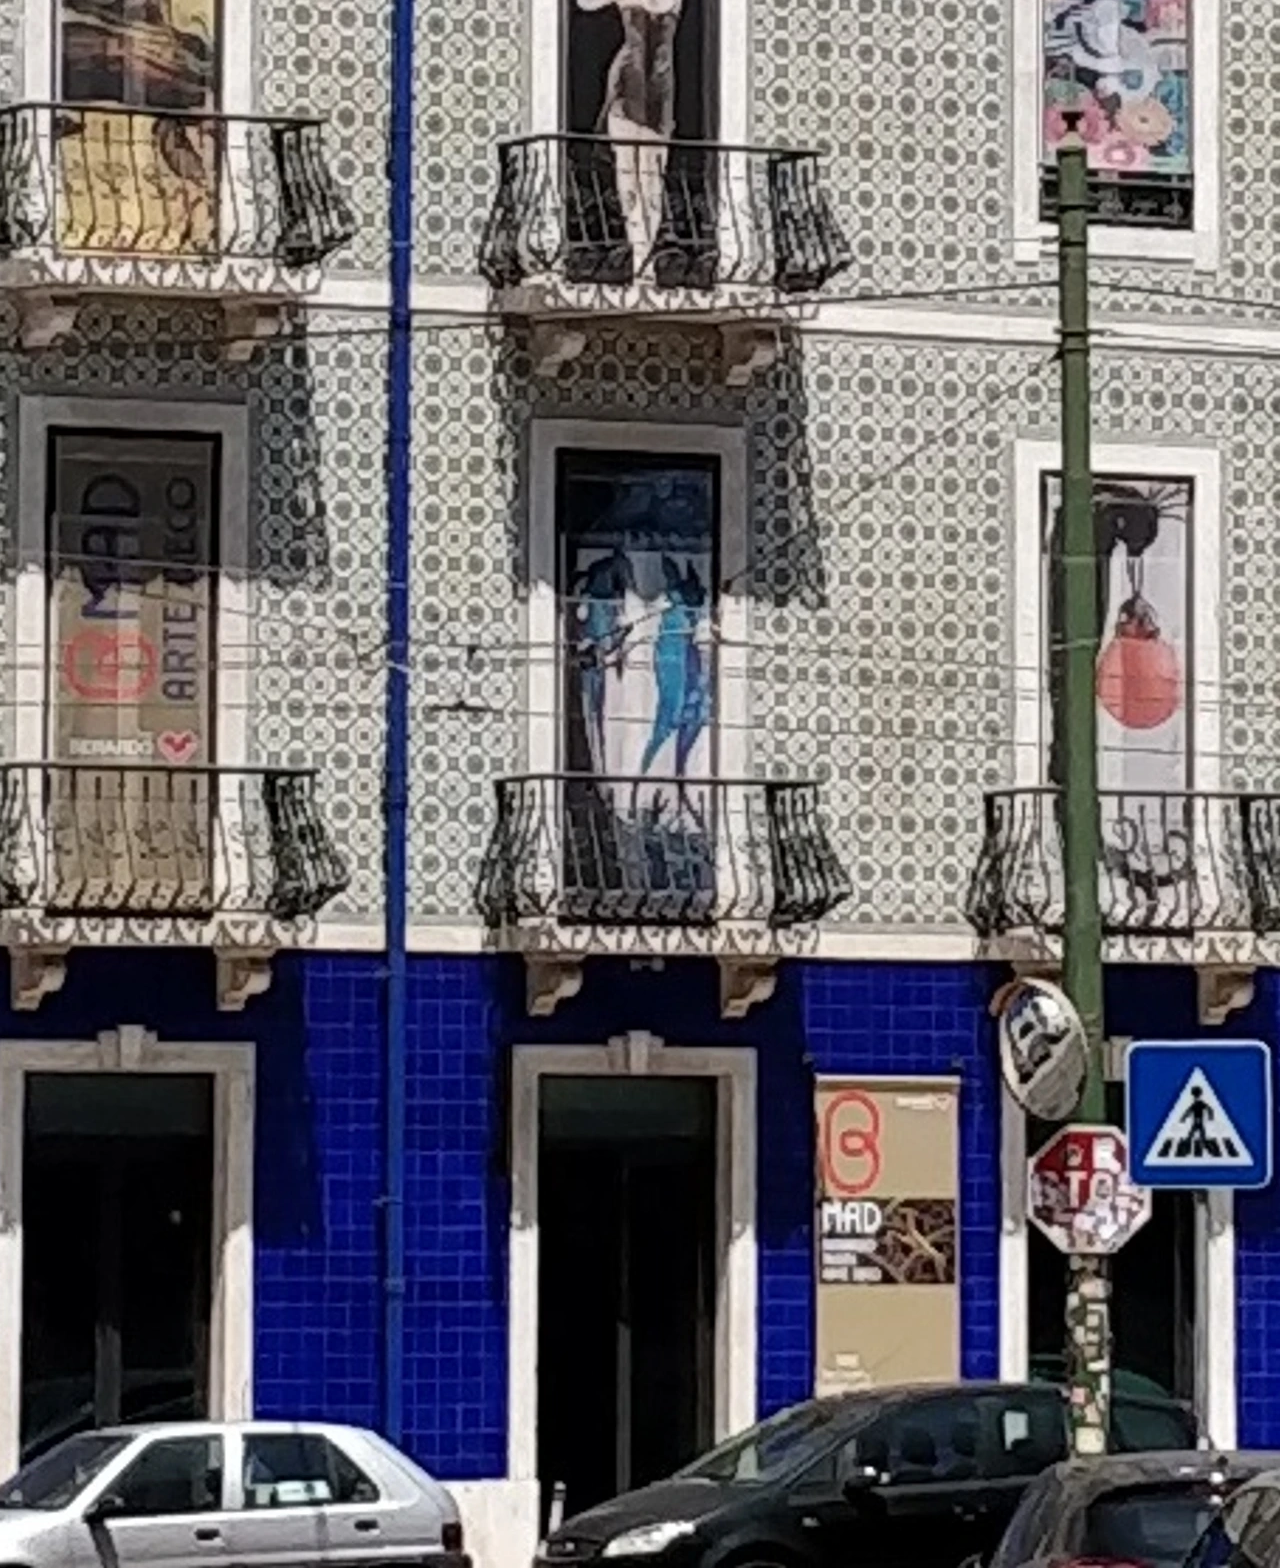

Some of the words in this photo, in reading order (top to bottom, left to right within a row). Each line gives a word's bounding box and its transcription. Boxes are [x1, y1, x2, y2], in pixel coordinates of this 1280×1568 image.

[80, 473, 141, 619] MAD
[163, 600, 197, 701] ARTE
[821, 1200, 883, 1234] MAD
